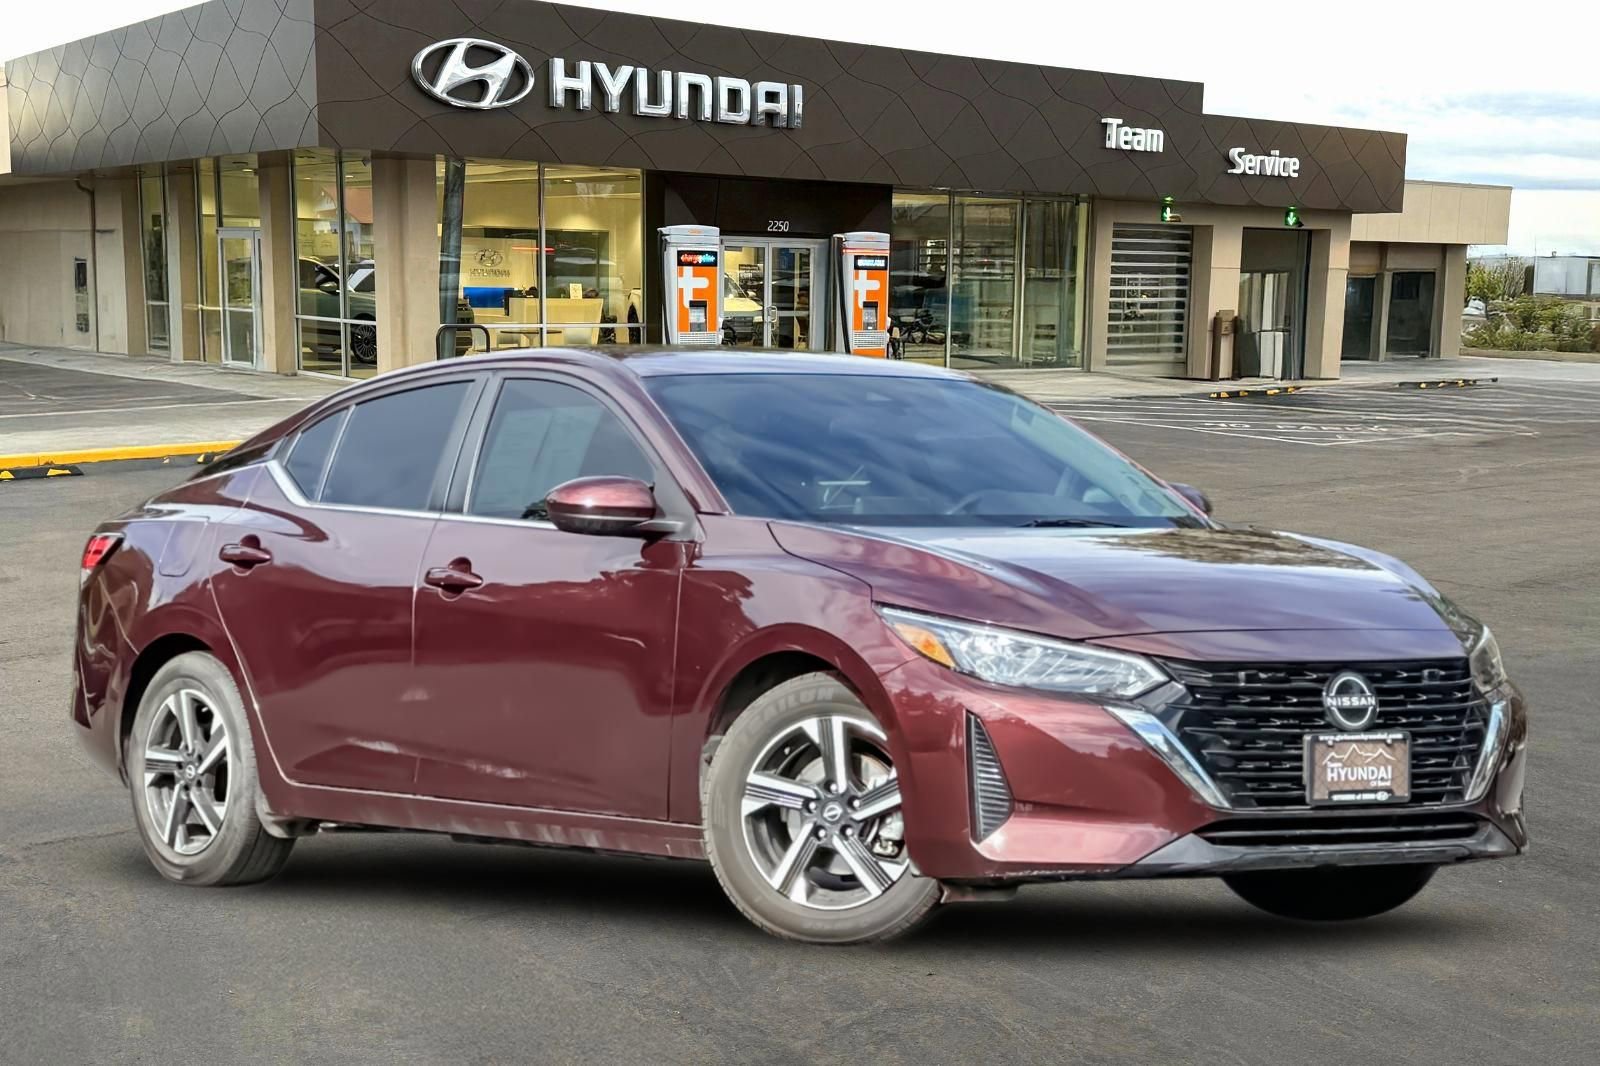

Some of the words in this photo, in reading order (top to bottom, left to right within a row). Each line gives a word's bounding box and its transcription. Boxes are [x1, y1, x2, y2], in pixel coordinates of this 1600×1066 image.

[549, 57, 803, 129] HYUNDAI
[1101, 117, 1164, 152] Team
[1227, 147, 1300, 177] Service
[767, 220, 790, 232] 2250
[1326, 696, 1376, 706] NISSAN
[1326, 765, 1392, 782] HYUNDAI
